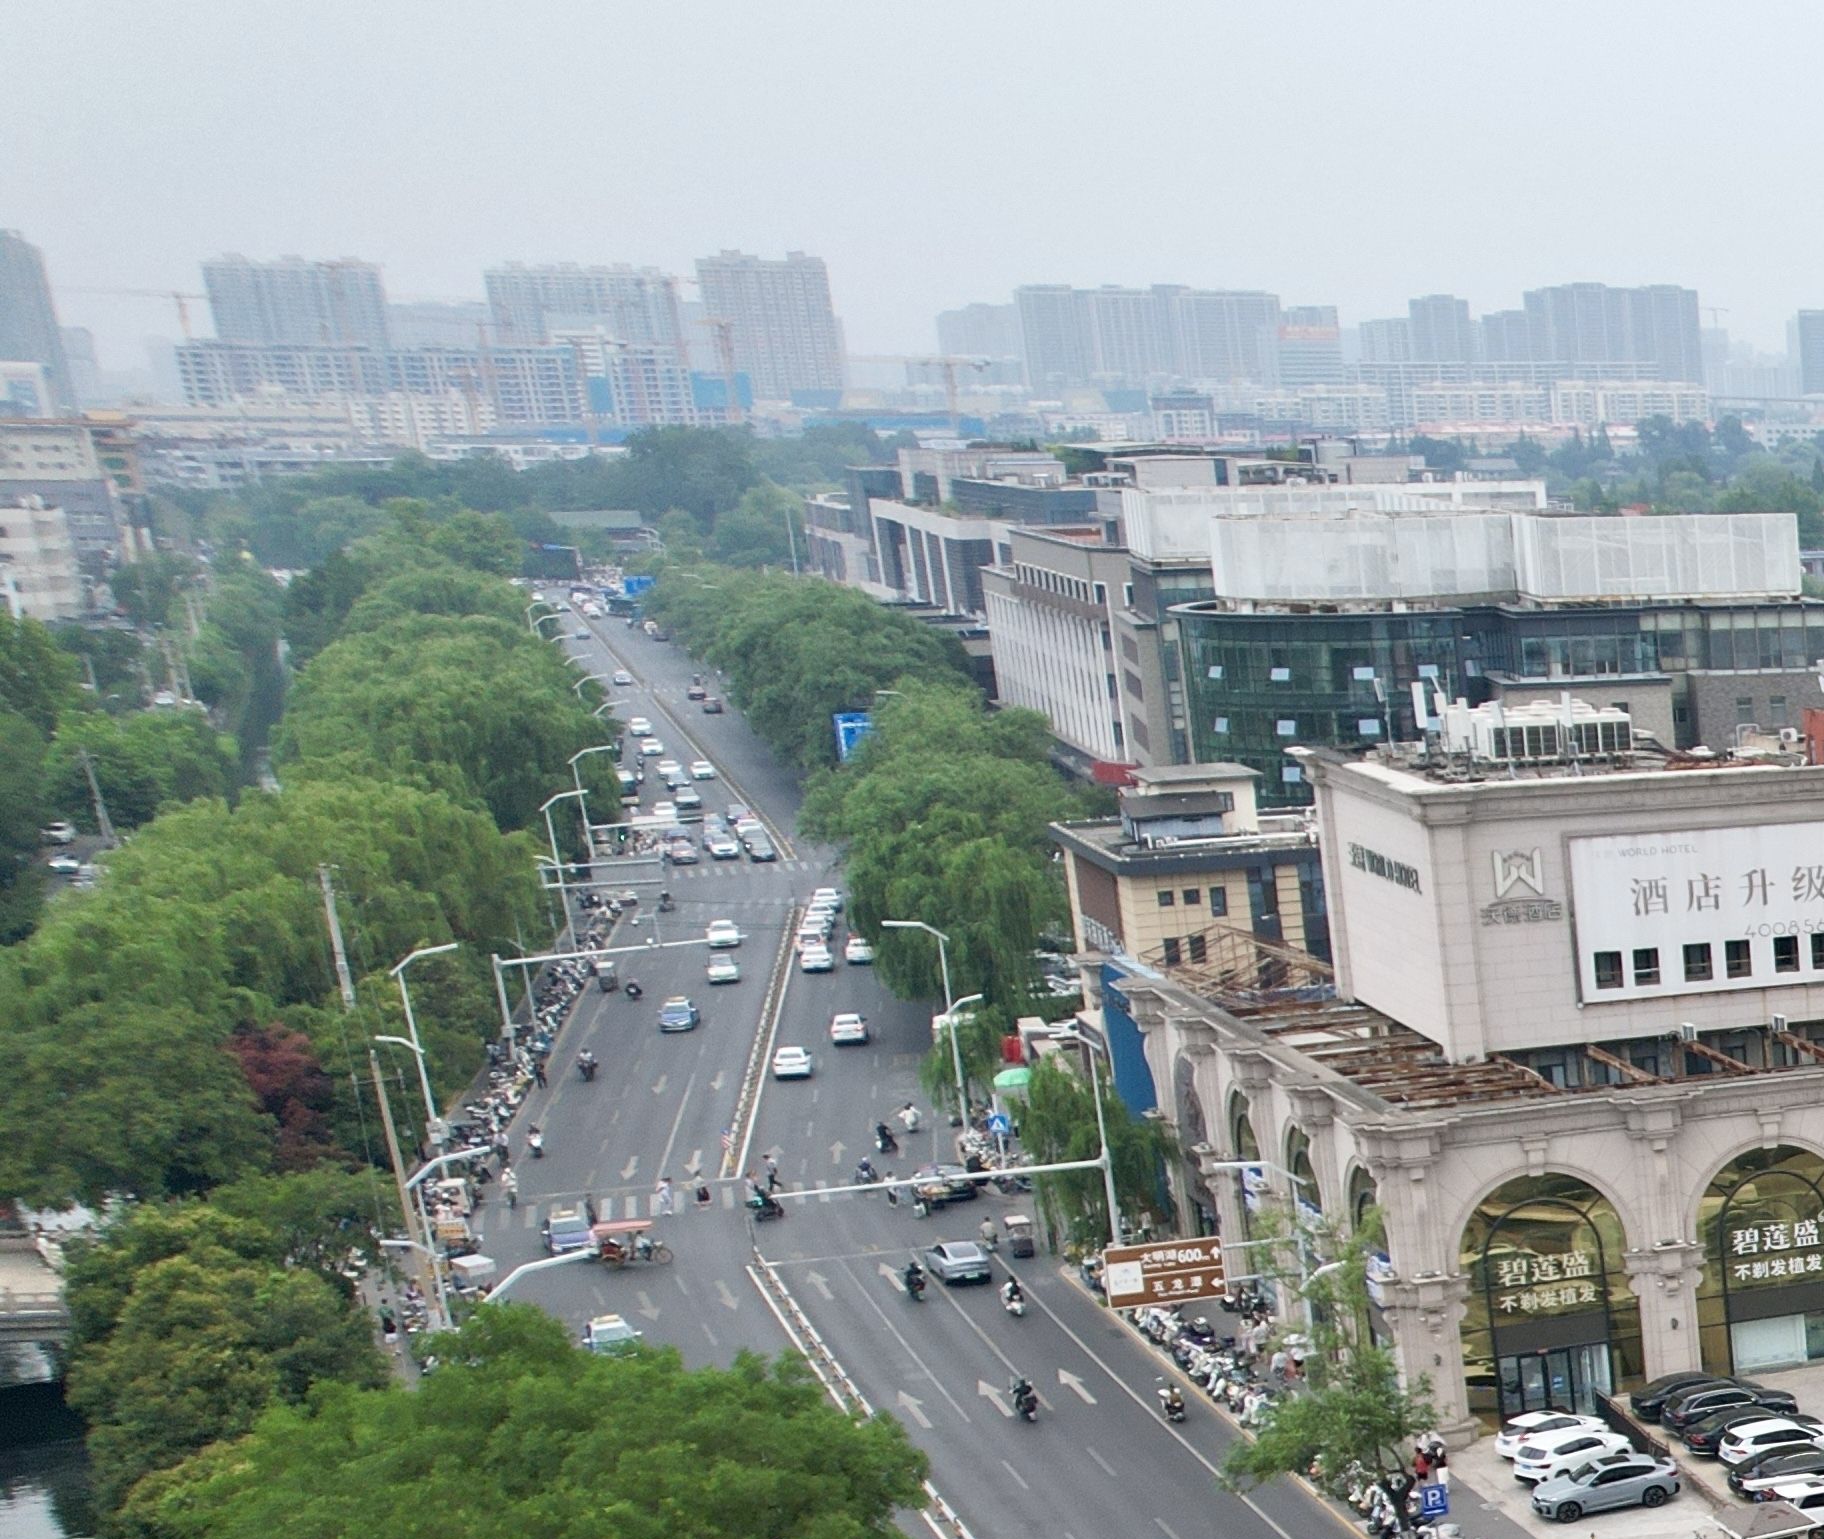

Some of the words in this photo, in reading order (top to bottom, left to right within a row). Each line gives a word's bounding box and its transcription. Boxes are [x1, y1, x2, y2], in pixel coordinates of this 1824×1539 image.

[1480, 902, 1562, 926] 沃德酒店
[1731, 1219, 1821, 1256] 碧莲盛
[1140, 1249, 1177, 1264] 大明湖
[1499, 1251, 1594, 1288] 碧莲盛
[1734, 1253, 1823, 1281] 不剃发植发
[1500, 1286, 1597, 1313] 不剃发植发
